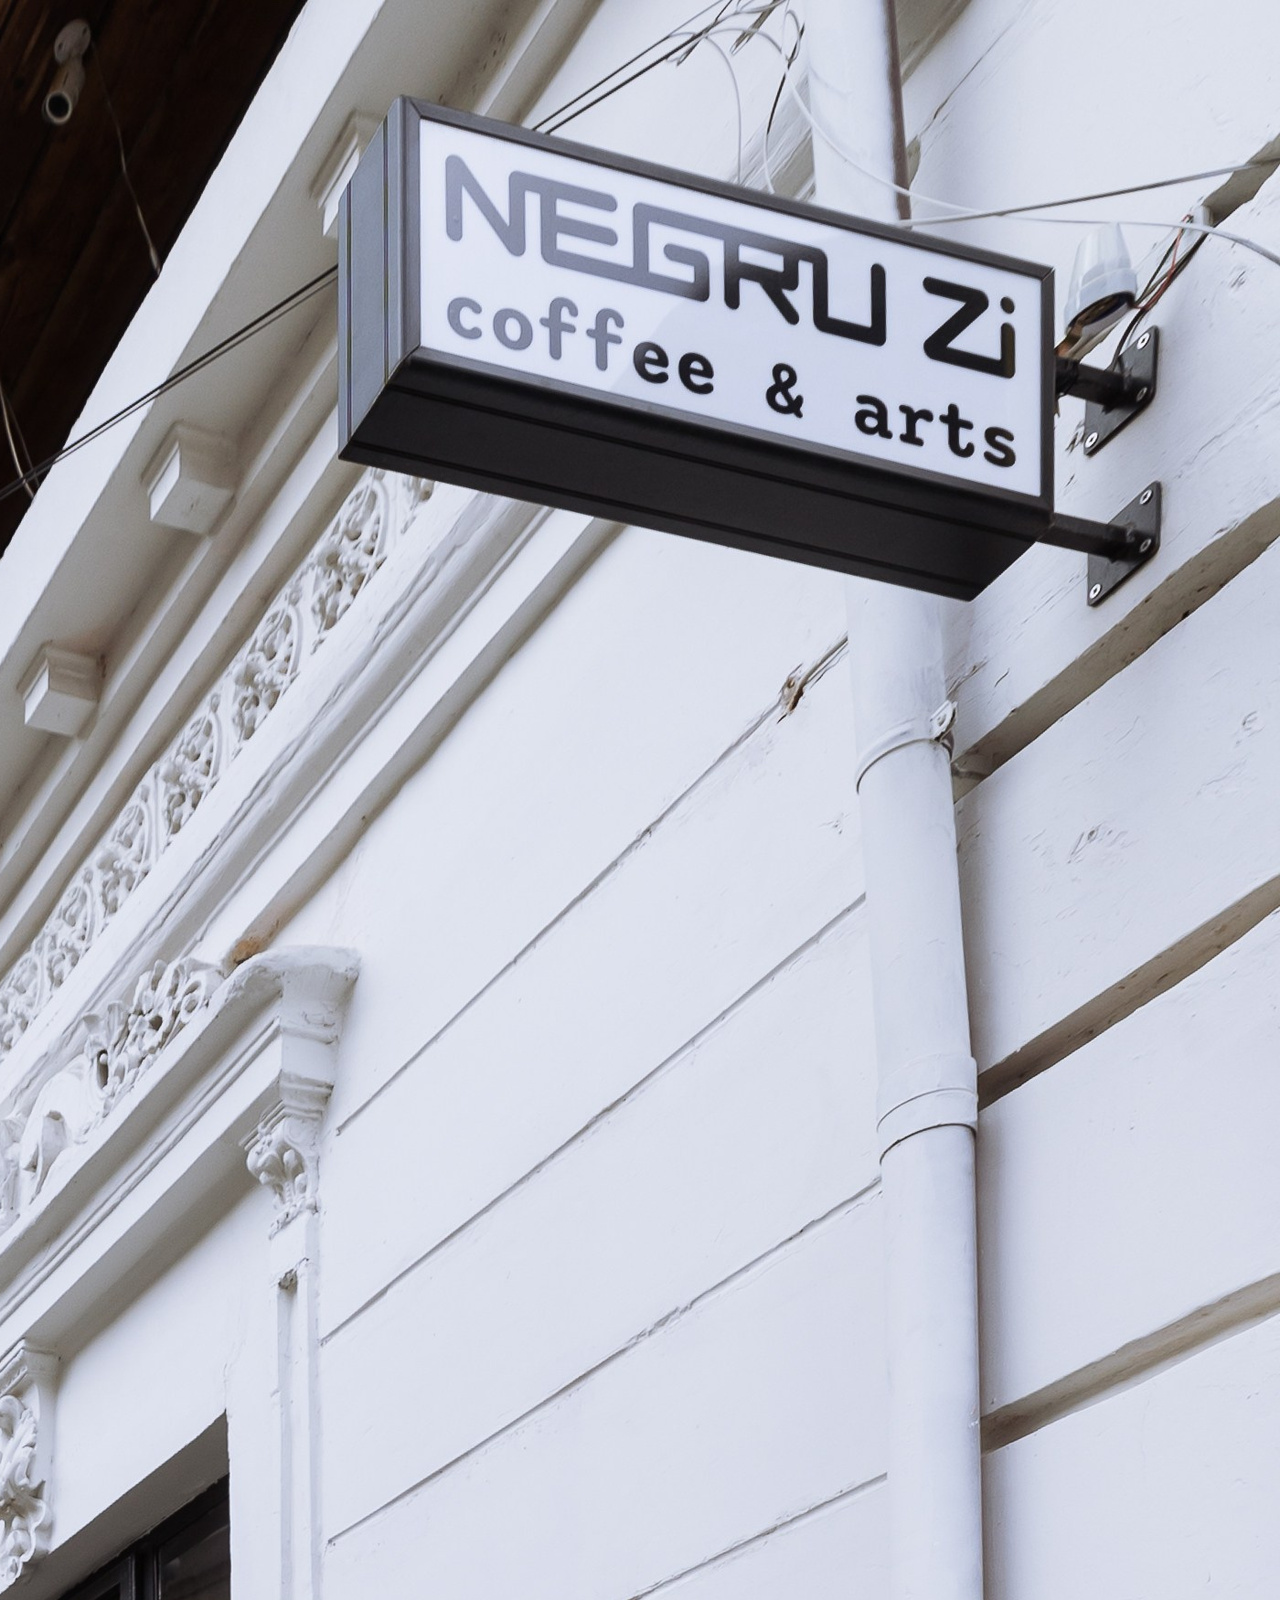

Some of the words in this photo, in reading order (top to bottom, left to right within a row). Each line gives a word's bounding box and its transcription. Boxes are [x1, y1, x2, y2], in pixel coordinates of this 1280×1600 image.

[447, 296, 715, 395] coffee
[765, 362, 804, 419] &
[854, 393, 1017, 468] arts
